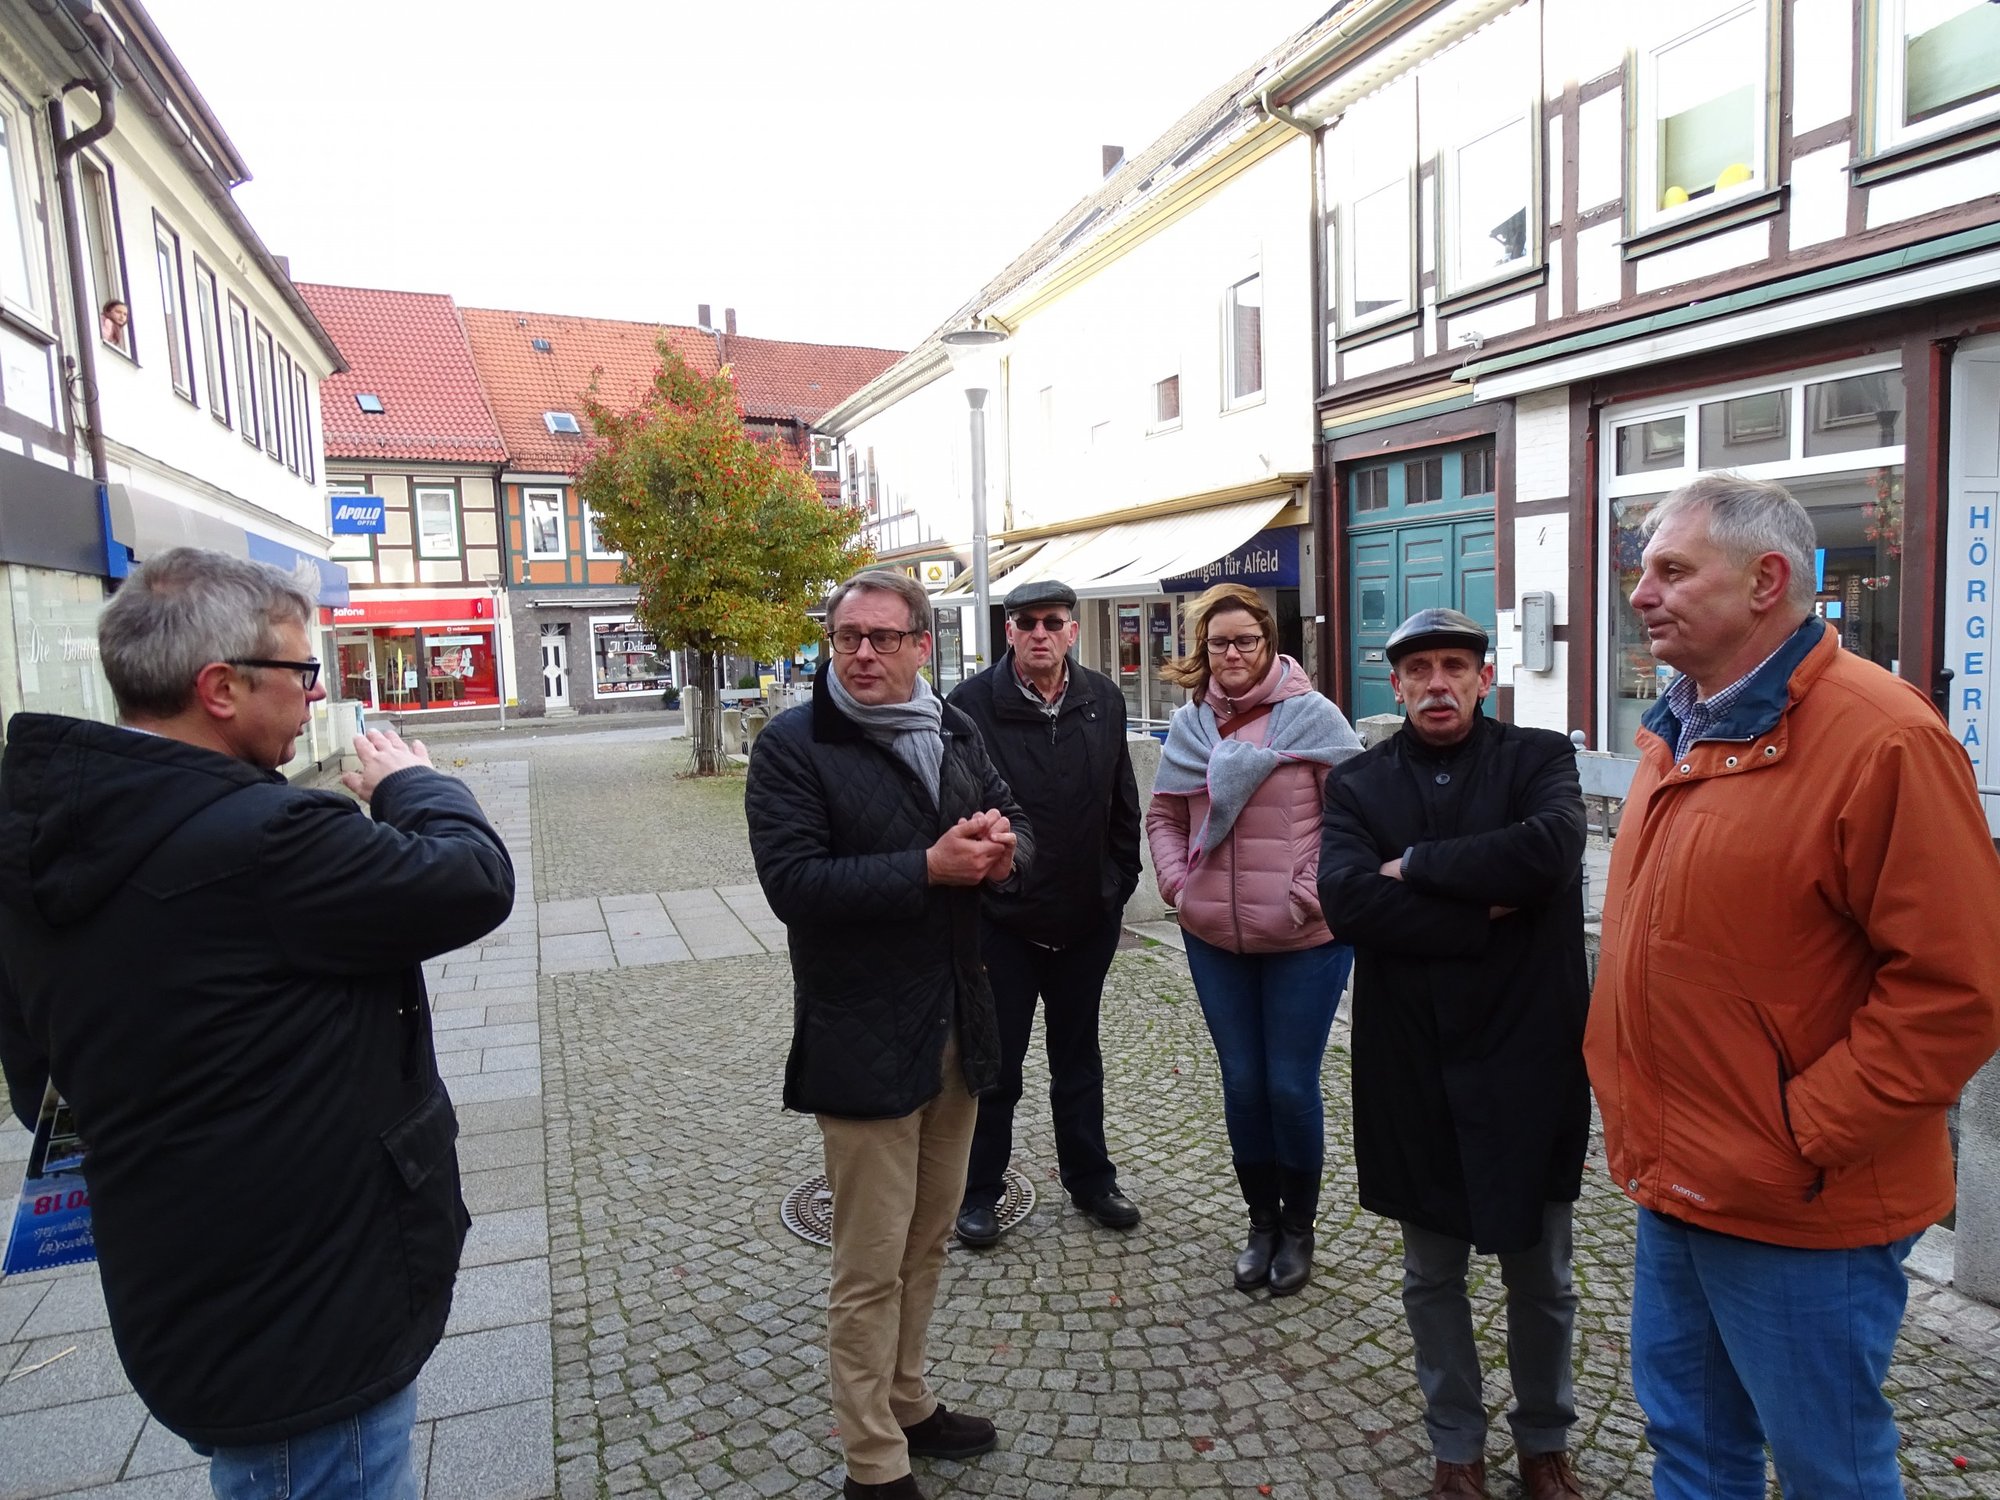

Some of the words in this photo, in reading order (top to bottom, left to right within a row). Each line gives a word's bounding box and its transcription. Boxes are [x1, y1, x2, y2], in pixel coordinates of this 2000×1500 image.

[335, 505, 381, 520] APOLLO
[1224, 554, 1241, 576] für
[1244, 549, 1279, 575] Alfeld
[1306, 544, 1311, 556] 5
[23, 617, 50, 664] Die
[1962, 506, 1990, 765] HÖRGERÄ
